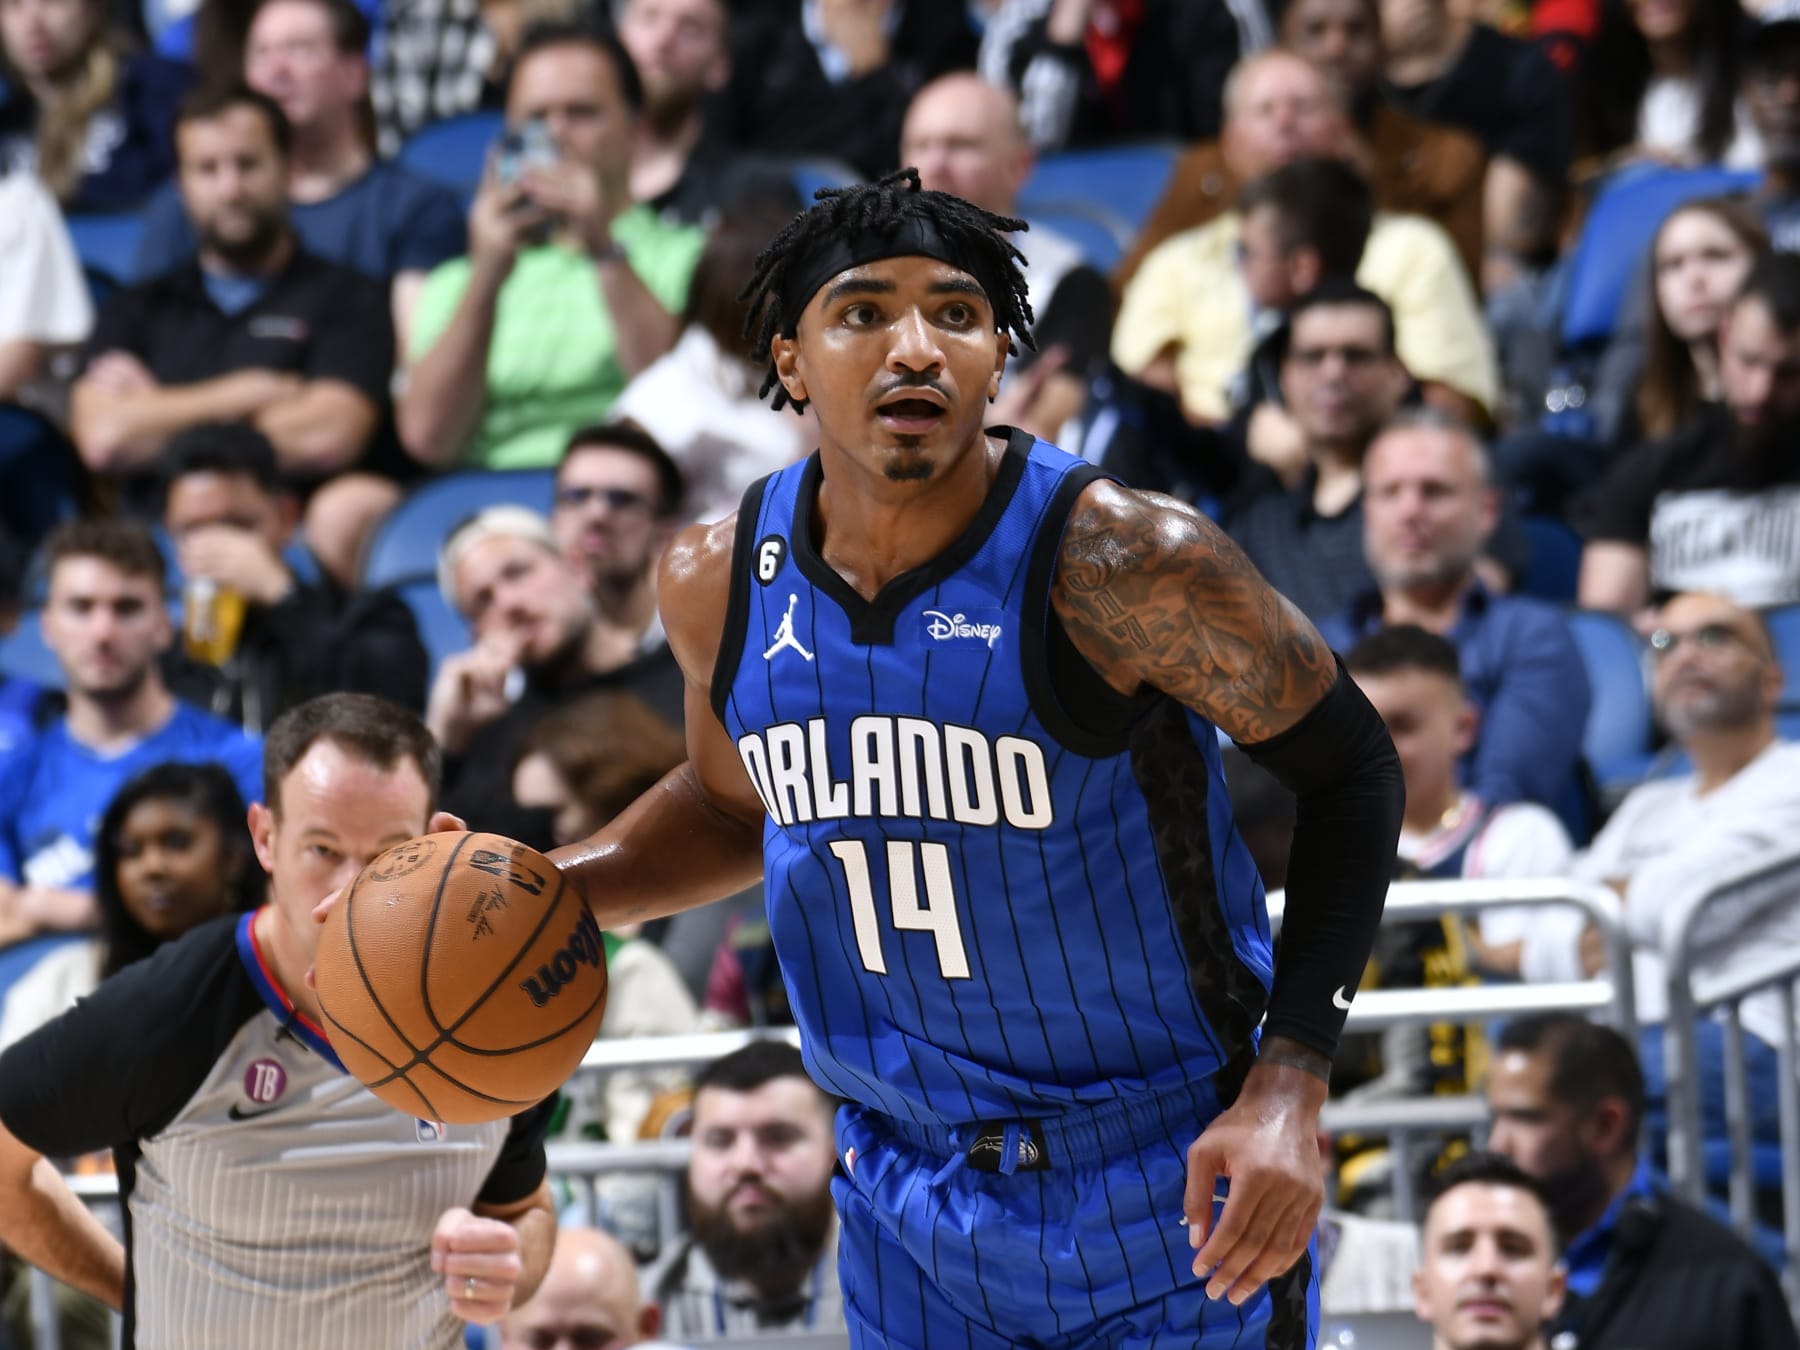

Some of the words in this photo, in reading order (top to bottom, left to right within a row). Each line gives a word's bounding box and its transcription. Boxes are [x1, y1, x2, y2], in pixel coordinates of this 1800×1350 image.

[759, 541, 781, 580] 6
[737, 715, 1054, 830] ORLANDO
[828, 837, 972, 980] 14
[252, 1063, 280, 1102] TB
